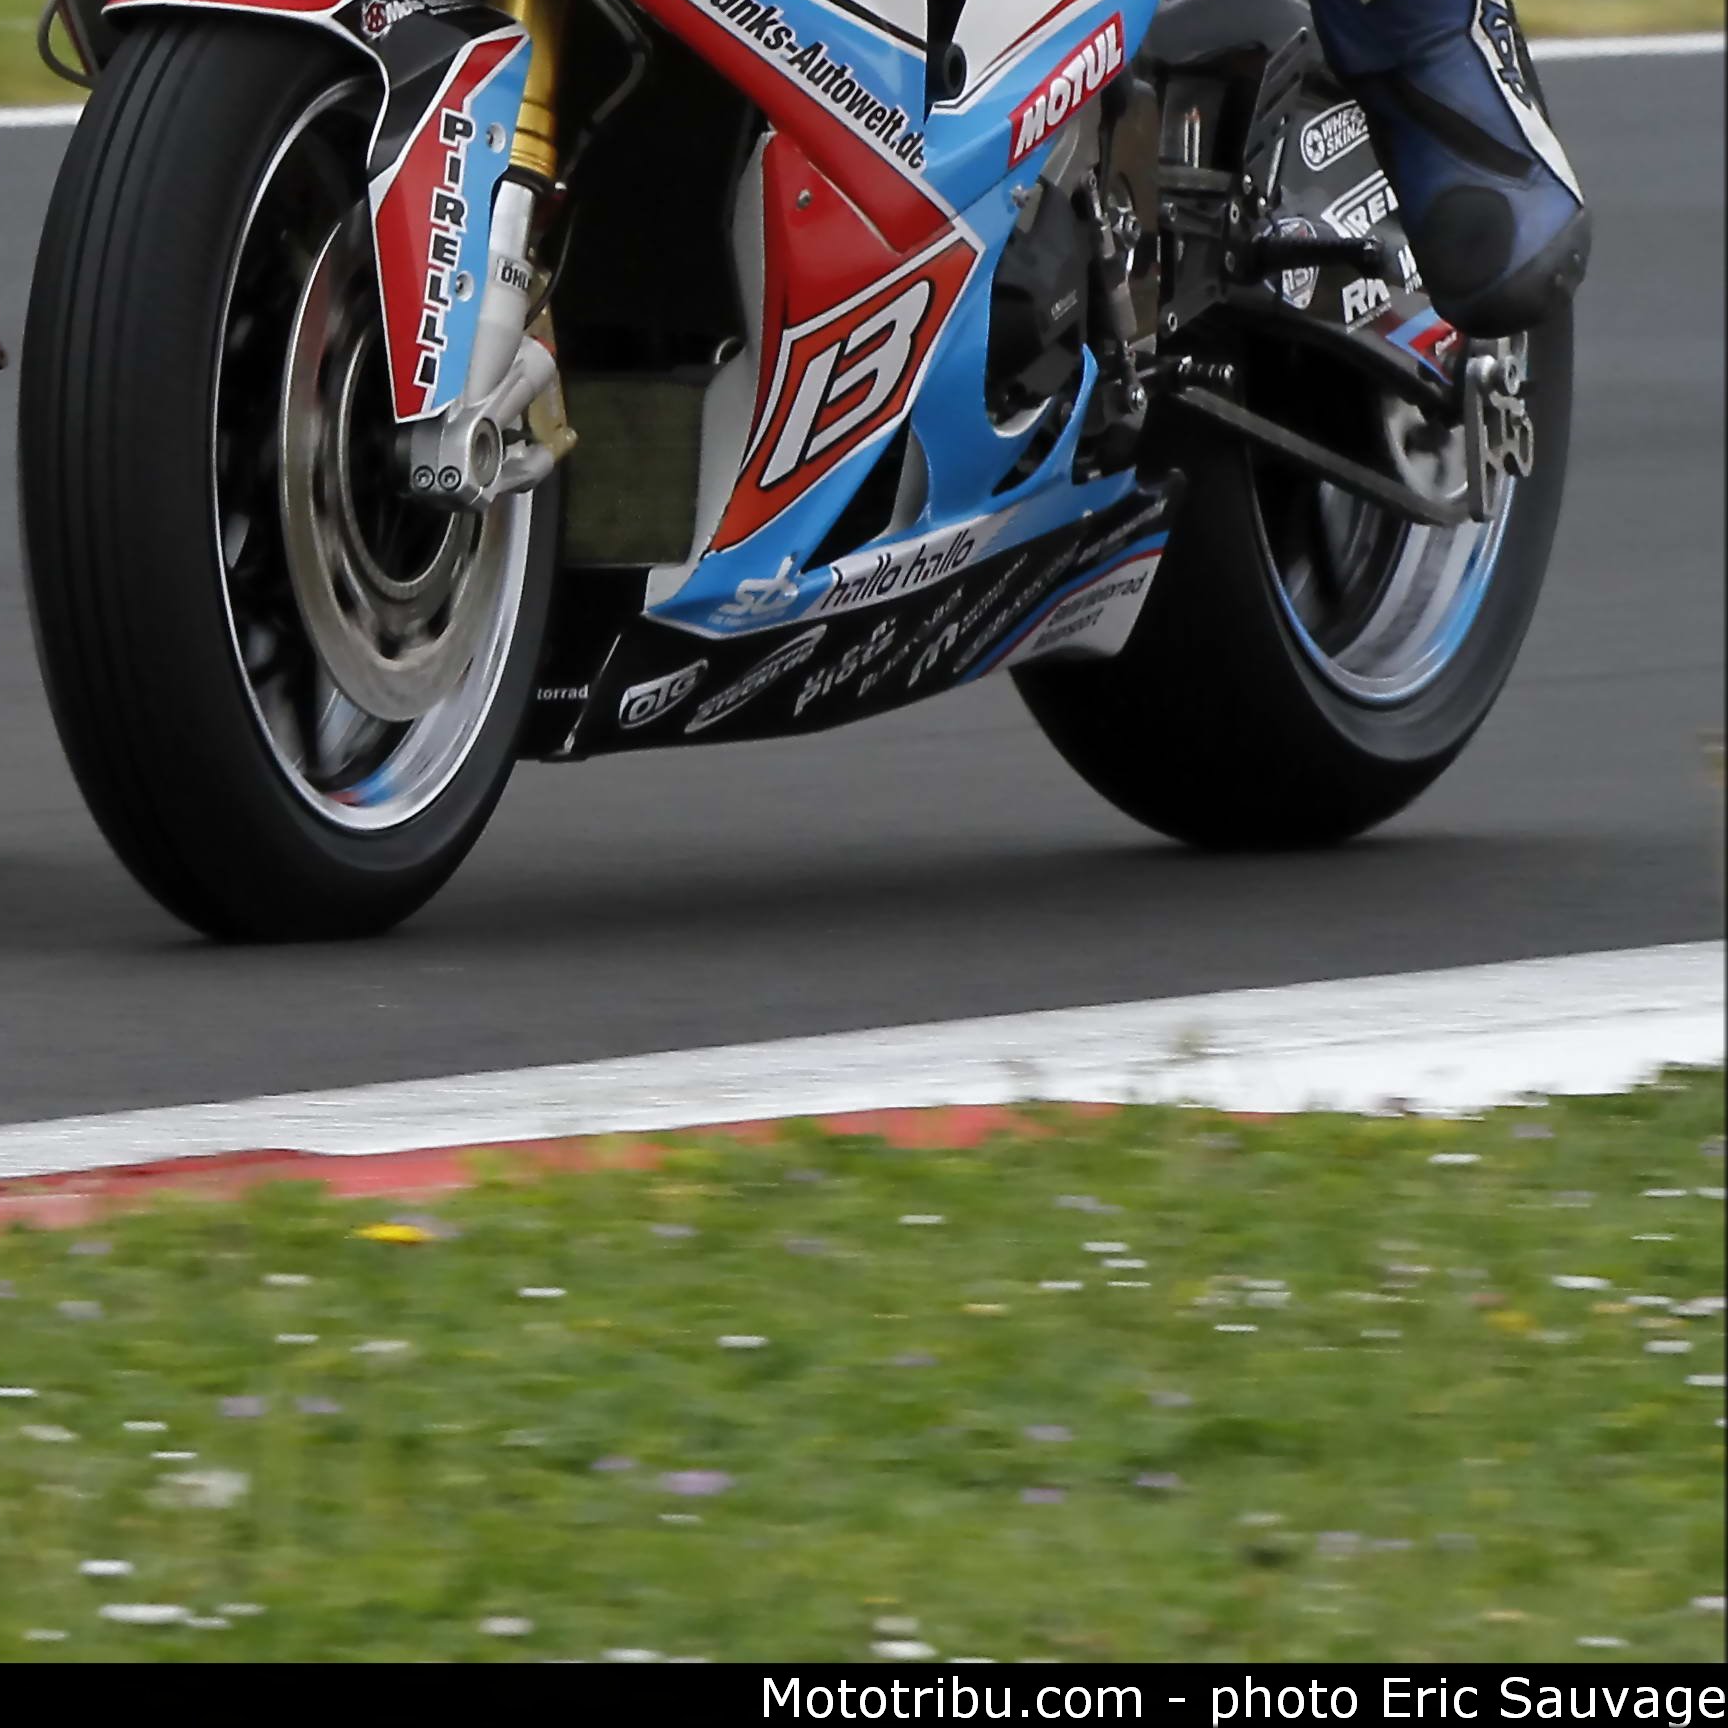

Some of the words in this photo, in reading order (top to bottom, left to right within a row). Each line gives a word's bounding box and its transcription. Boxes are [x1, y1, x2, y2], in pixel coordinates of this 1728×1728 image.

[1013, 28, 1125, 162] MOTUL
[413, 109, 474, 387] PIRELLI
[758, 279, 932, 490] 13
[536, 683, 589, 701] torrad
